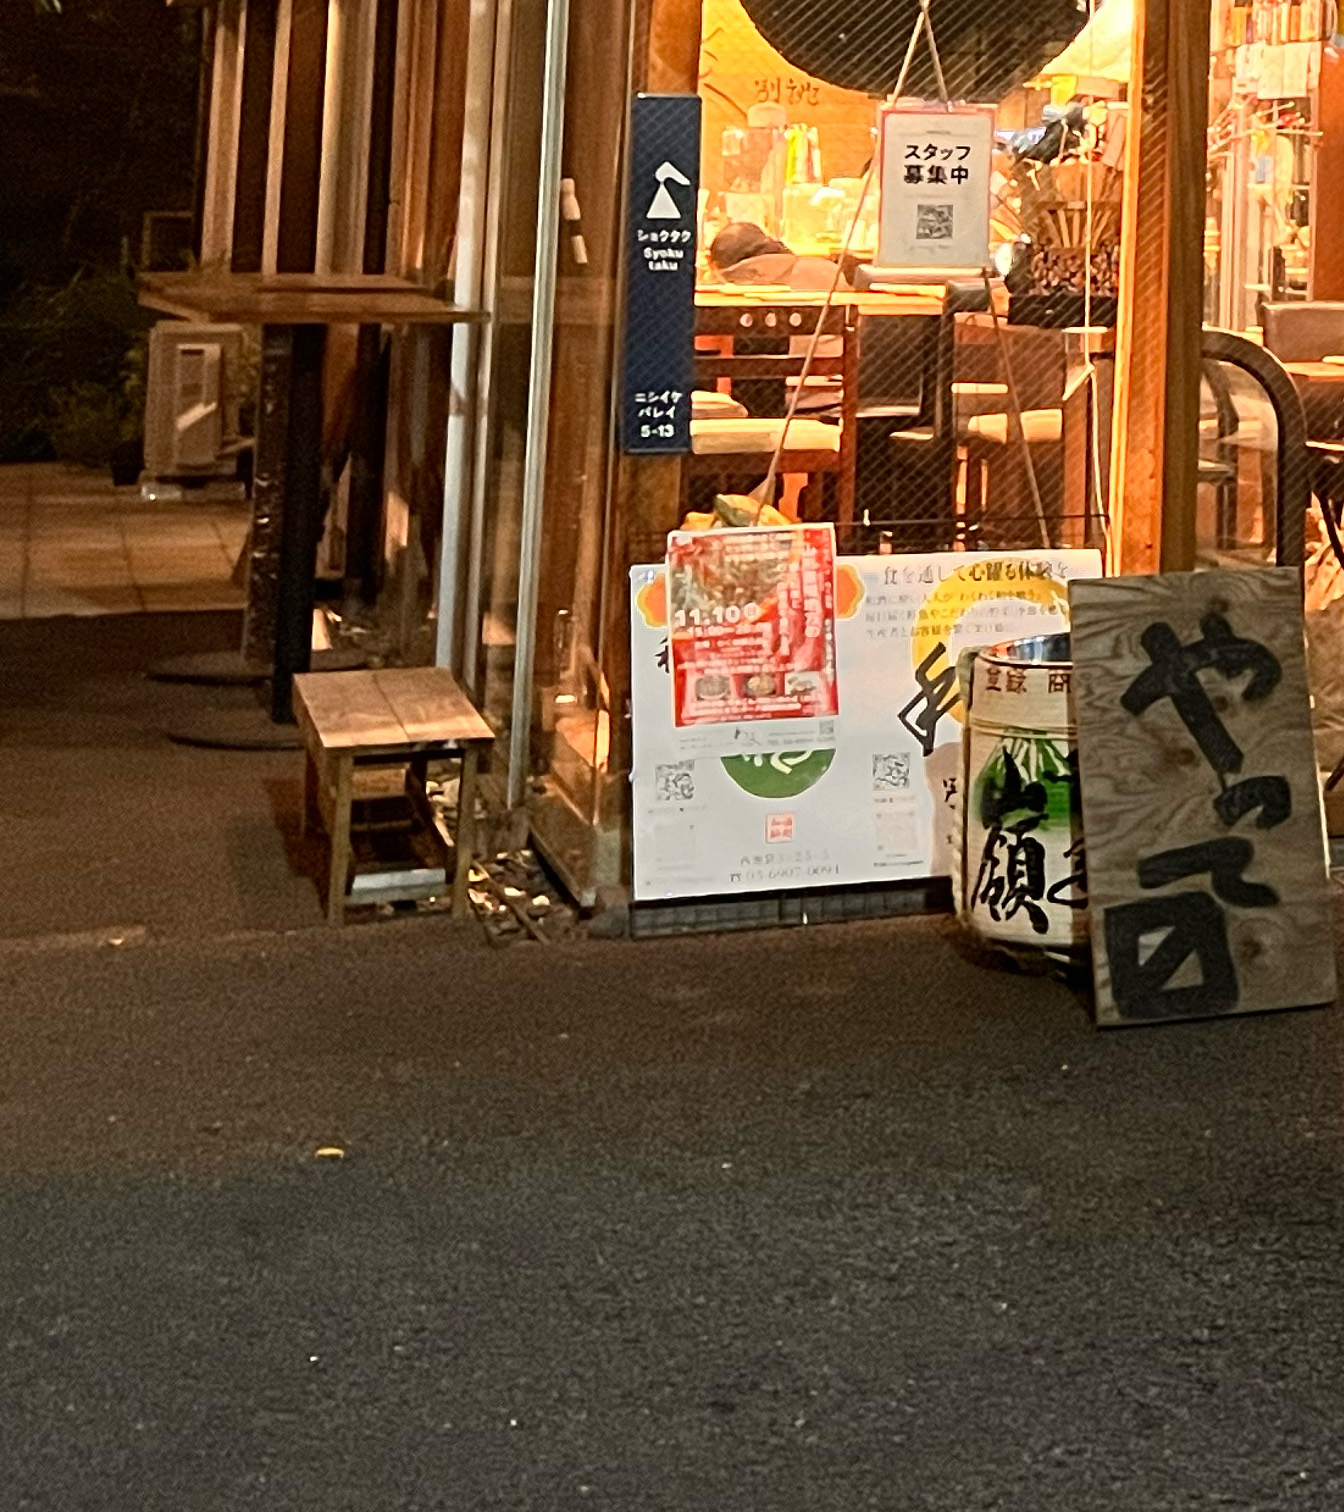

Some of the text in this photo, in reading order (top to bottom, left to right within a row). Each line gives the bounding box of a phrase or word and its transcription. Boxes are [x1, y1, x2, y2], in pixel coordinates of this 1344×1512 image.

[904, 143, 971, 161] スタッフ
[903, 164, 969, 185] 募集中
[637, 229, 692, 243] ショクタク
[634, 390, 683, 404] ニシイケ
